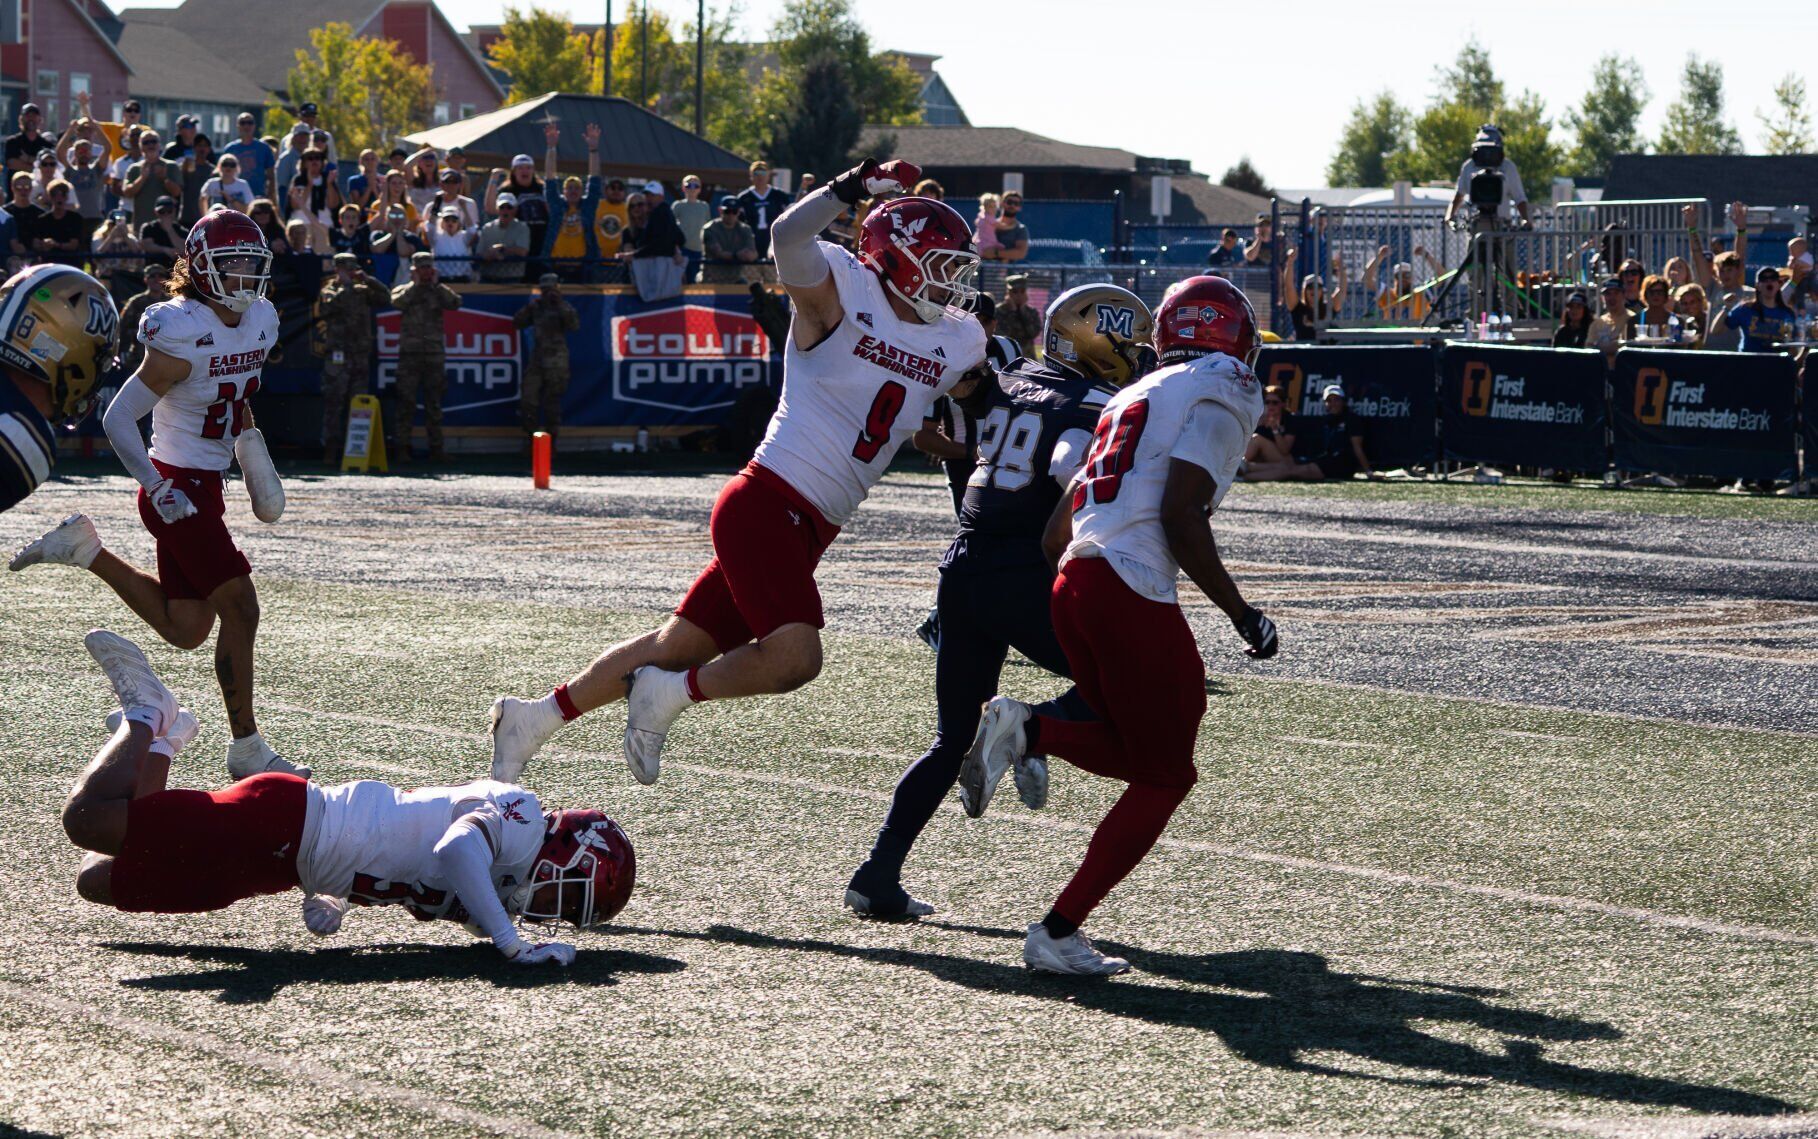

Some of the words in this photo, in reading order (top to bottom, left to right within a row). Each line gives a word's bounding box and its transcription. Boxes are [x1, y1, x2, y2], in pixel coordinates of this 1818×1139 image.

[757, 207, 768, 229] 1
[16, 315, 37, 339] 8
[1096, 304, 1136, 340] M
[377, 326, 512, 354] twn
[624, 327, 761, 354] town
[4, 348, 32, 369] STATE
[208, 361, 263, 377] WASHINGTO
[852, 344, 941, 389] WASHINGTON
[857, 334, 948, 378] EASTERN
[377, 362, 513, 390] pmp
[629, 362, 761, 390] pump
[1494, 375, 1525, 397] First
[1669, 381, 1704, 404] First
[1303, 397, 1379, 417] Inttate
[1379, 397, 1411, 417] Bank
[1491, 398, 1555, 422] Interstate
[1555, 402, 1584, 424] Bank
[1666, 405, 1738, 429] Interstate
[1739, 408, 1771, 431] Bank
[852, 380, 907, 464] 9
